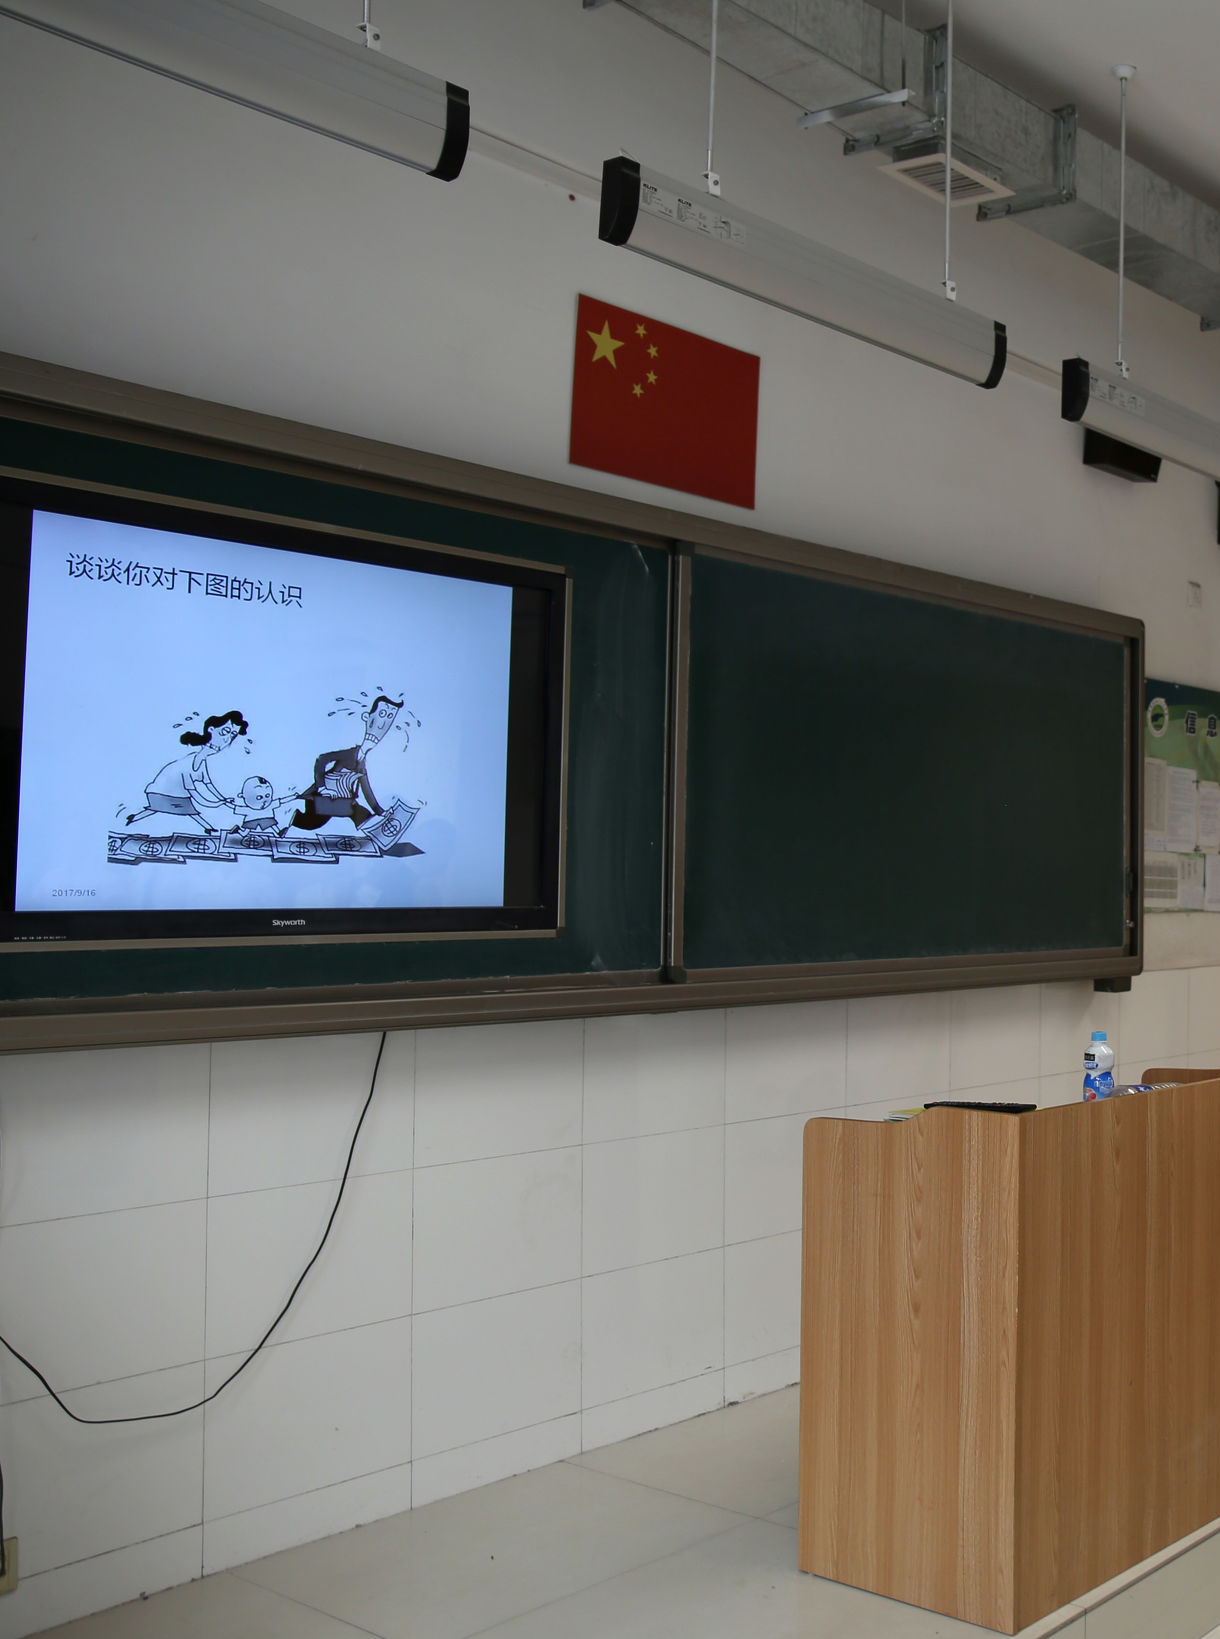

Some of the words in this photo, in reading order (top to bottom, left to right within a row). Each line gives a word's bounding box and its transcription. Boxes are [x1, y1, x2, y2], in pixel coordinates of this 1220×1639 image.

[66, 552, 303, 608] 谈谈你对下图的认识
[52, 888, 96, 897] 2017/9/16
[272, 919, 306, 927] Skyworth
